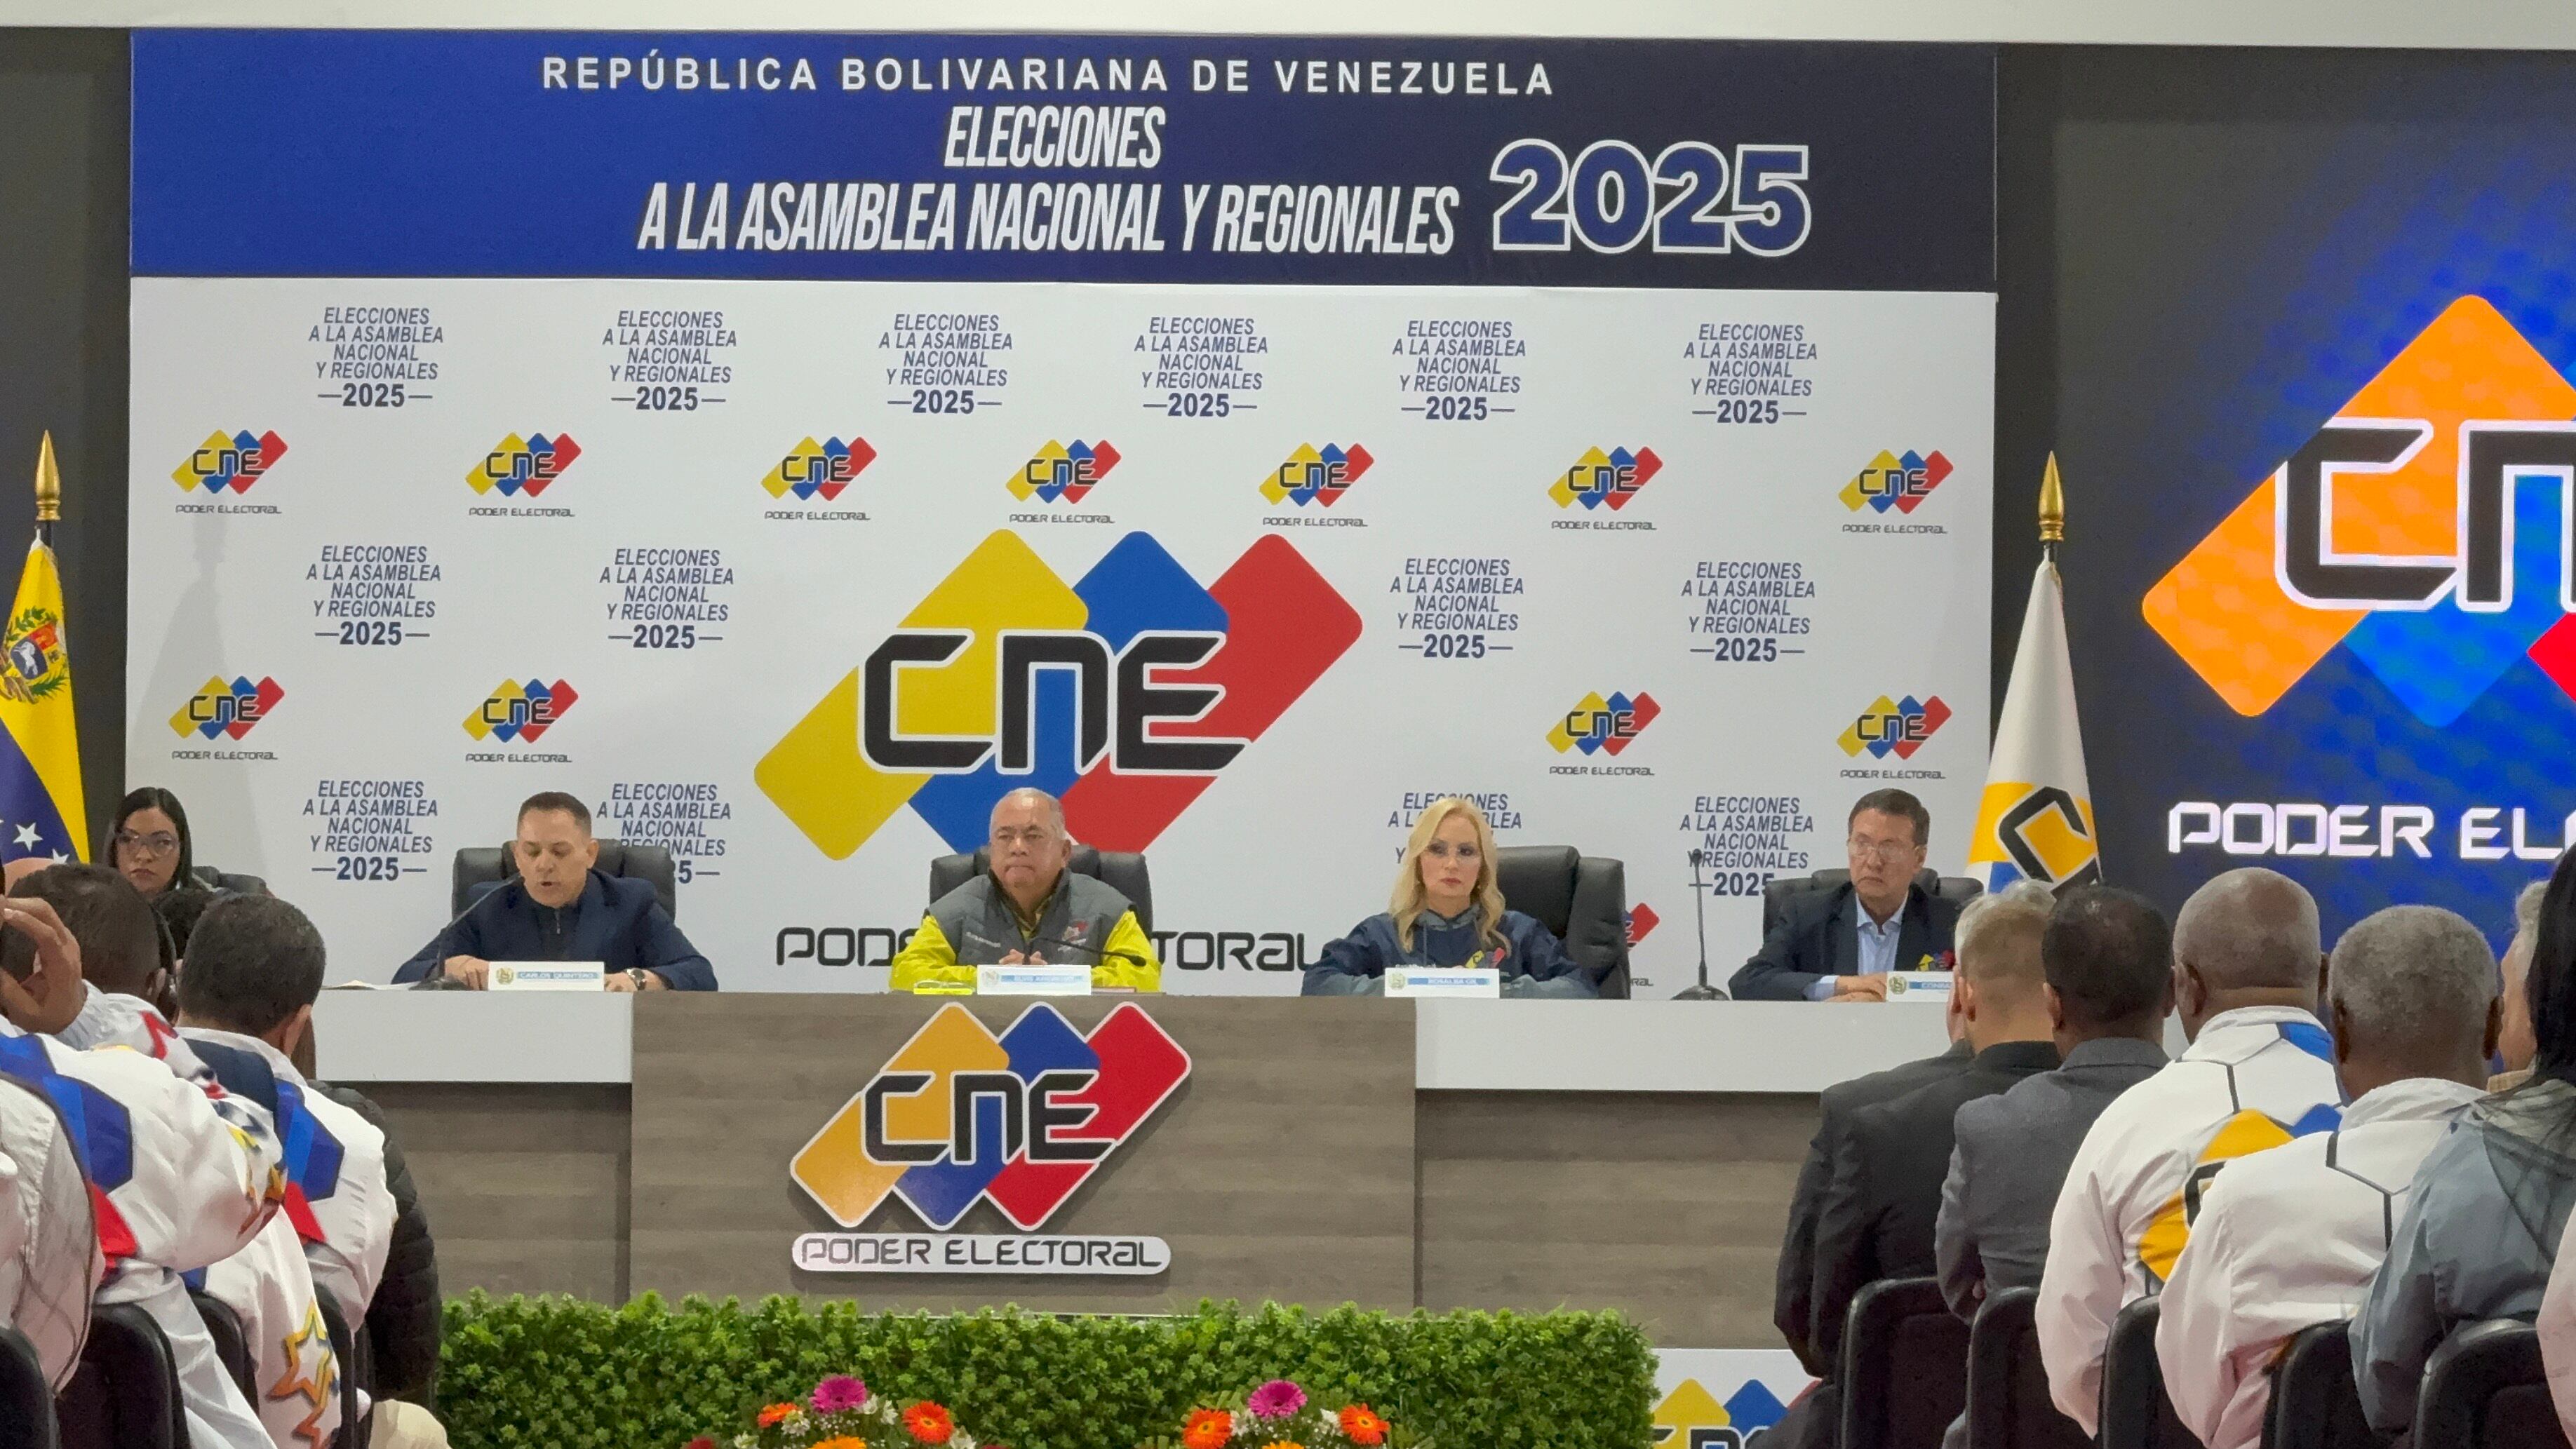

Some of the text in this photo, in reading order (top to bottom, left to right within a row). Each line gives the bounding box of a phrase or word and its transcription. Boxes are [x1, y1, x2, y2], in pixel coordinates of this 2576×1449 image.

[542, 49, 1553, 95] REPÚBLICA BOLIVARIANA DE VENEZUELA
[944, 105, 1166, 168] ELECCIONES
[637, 138, 1812, 258] A LA ASAMBLEA NACIONAL Y REGIONALES 2025
[324, 307, 429, 325] ELECCIONES
[617, 311, 723, 328] ELECCIONES
[894, 314, 998, 331] ELECCIONES
[309, 325, 443, 343] A LA ASAMBLEA
[1150, 317, 1254, 335] ELECCIONES
[1408, 321, 1512, 338] ELECCIONES
[1699, 324, 1804, 341] ELECCIONES
[603, 329, 736, 346] A LA ASAMBLEA
[879, 332, 1012, 349] A LA ASAMBLEA
[1134, 335, 1267, 353] A LA ASAMBLEA
[334, 344, 418, 361] NACIONAL
[627, 348, 711, 364] NACIONAL
[1393, 339, 1525, 356] A LA ASAMBLEA
[1684, 342, 1817, 359] A LA ASAMBLEA
[904, 351, 988, 368] NACIONAL
[1160, 354, 1243, 371] NACIONAL
[1417, 358, 1501, 374] NACIONAL
[316, 362, 438, 379] Y REGIONALES
[610, 365, 731, 383] Y REGIONALES
[1709, 360, 1792, 377] NACIONAL
[887, 369, 1007, 386] Y REGIONALES
[1142, 372, 1262, 390] Y REGIONALES
[1400, 375, 1520, 393] Y REGIONALES
[343, 383, 404, 407] 2025
[1691, 379, 1812, 396] Y REGIONALES
[636, 386, 697, 410] 2025
[913, 390, 974, 414] 2025
[1168, 393, 1229, 417] 2025
[1426, 396, 1487, 420] 2025
[1717, 400, 1778, 424] 2025
[193, 450, 265, 476] CNE
[486, 452, 559, 478] CNE
[782, 456, 854, 482] CNE
[1026, 459, 1099, 485] CNE
[1280, 462, 1352, 488] CNE
[1569, 466, 1641, 492] CNE
[1859, 469, 1932, 495] CNE
[175, 505, 281, 514] PODER ELECTORAL
[469, 508, 575, 517] PODER ELECTORAL
[765, 511, 870, 520] PODER ELECTORAL
[1009, 514, 1115, 523] PODER ELECTORAL
[1263, 518, 1368, 527] PODER ELECTORAL
[1593, 522, 1657, 530] ELECTORAL
[1842, 525, 1947, 534] PODER ELECTORAL
[322, 546, 427, 562] ELECCIONES
[615, 548, 720, 566] ELECCIONES
[306, 564, 441, 581] A LA ASAMBLEA
[600, 567, 733, 584] A LA ASAMBLEA
[1405, 558, 1510, 576] ELECCIONES
[1697, 562, 1802, 579] ELECCIONES
[331, 582, 415, 599] NACIONAL
[624, 586, 709, 602] NACIONAL
[1390, 577, 1523, 594] A LA ASAMBLEA
[1682, 580, 1815, 598] A LA ASAMBLEA
[314, 600, 435, 617] Y REGIONALES
[1414, 595, 1498, 612] NACIONAL
[1706, 599, 1790, 615] NACIONAL
[608, 604, 728, 621] Y REGIONALES
[1398, 613, 1518, 631] Y REGIONALES
[1689, 616, 1810, 634] Y REGIONALES
[340, 621, 401, 645] 2025
[633, 624, 695, 649] 2025
[1424, 634, 1484, 659] 2025
[1715, 638, 1776, 662] 2025
[189, 696, 262, 722] CNE
[861, 631, 1249, 772] CNE
[483, 698, 556, 724] CNE
[1567, 711, 1639, 737] CNE
[1857, 715, 1930, 741] CNE
[172, 751, 278, 760] PODER ELECTORAL
[466, 753, 572, 762] PODER ELECTORAL
[1550, 767, 1654, 776] PODER ELECTORAL
[1840, 769, 1946, 779] PODER ELECTORAL
[318, 781, 424, 798] ELECCIONES
[612, 783, 717, 801] ELECCIONES
[303, 799, 437, 816] A LA ASAMBLEA
[596, 802, 730, 819] A LA ASAMBLEA
[1695, 797, 1799, 814] ELECCIONES
[328, 817, 412, 834] NACIONAL
[622, 821, 706, 837] NACIONAL
[1680, 815, 1813, 832] A LA ASAMBLEA
[2168, 801, 2435, 858] PODER
[311, 835, 432, 853] Y REGIONALES
[1704, 833, 1788, 850] NACIONAL
[337, 856, 398, 881] 2025
[864, 1073, 1115, 1164] CNE
[801, 1237, 1162, 1268] PODER ELECTORAL
